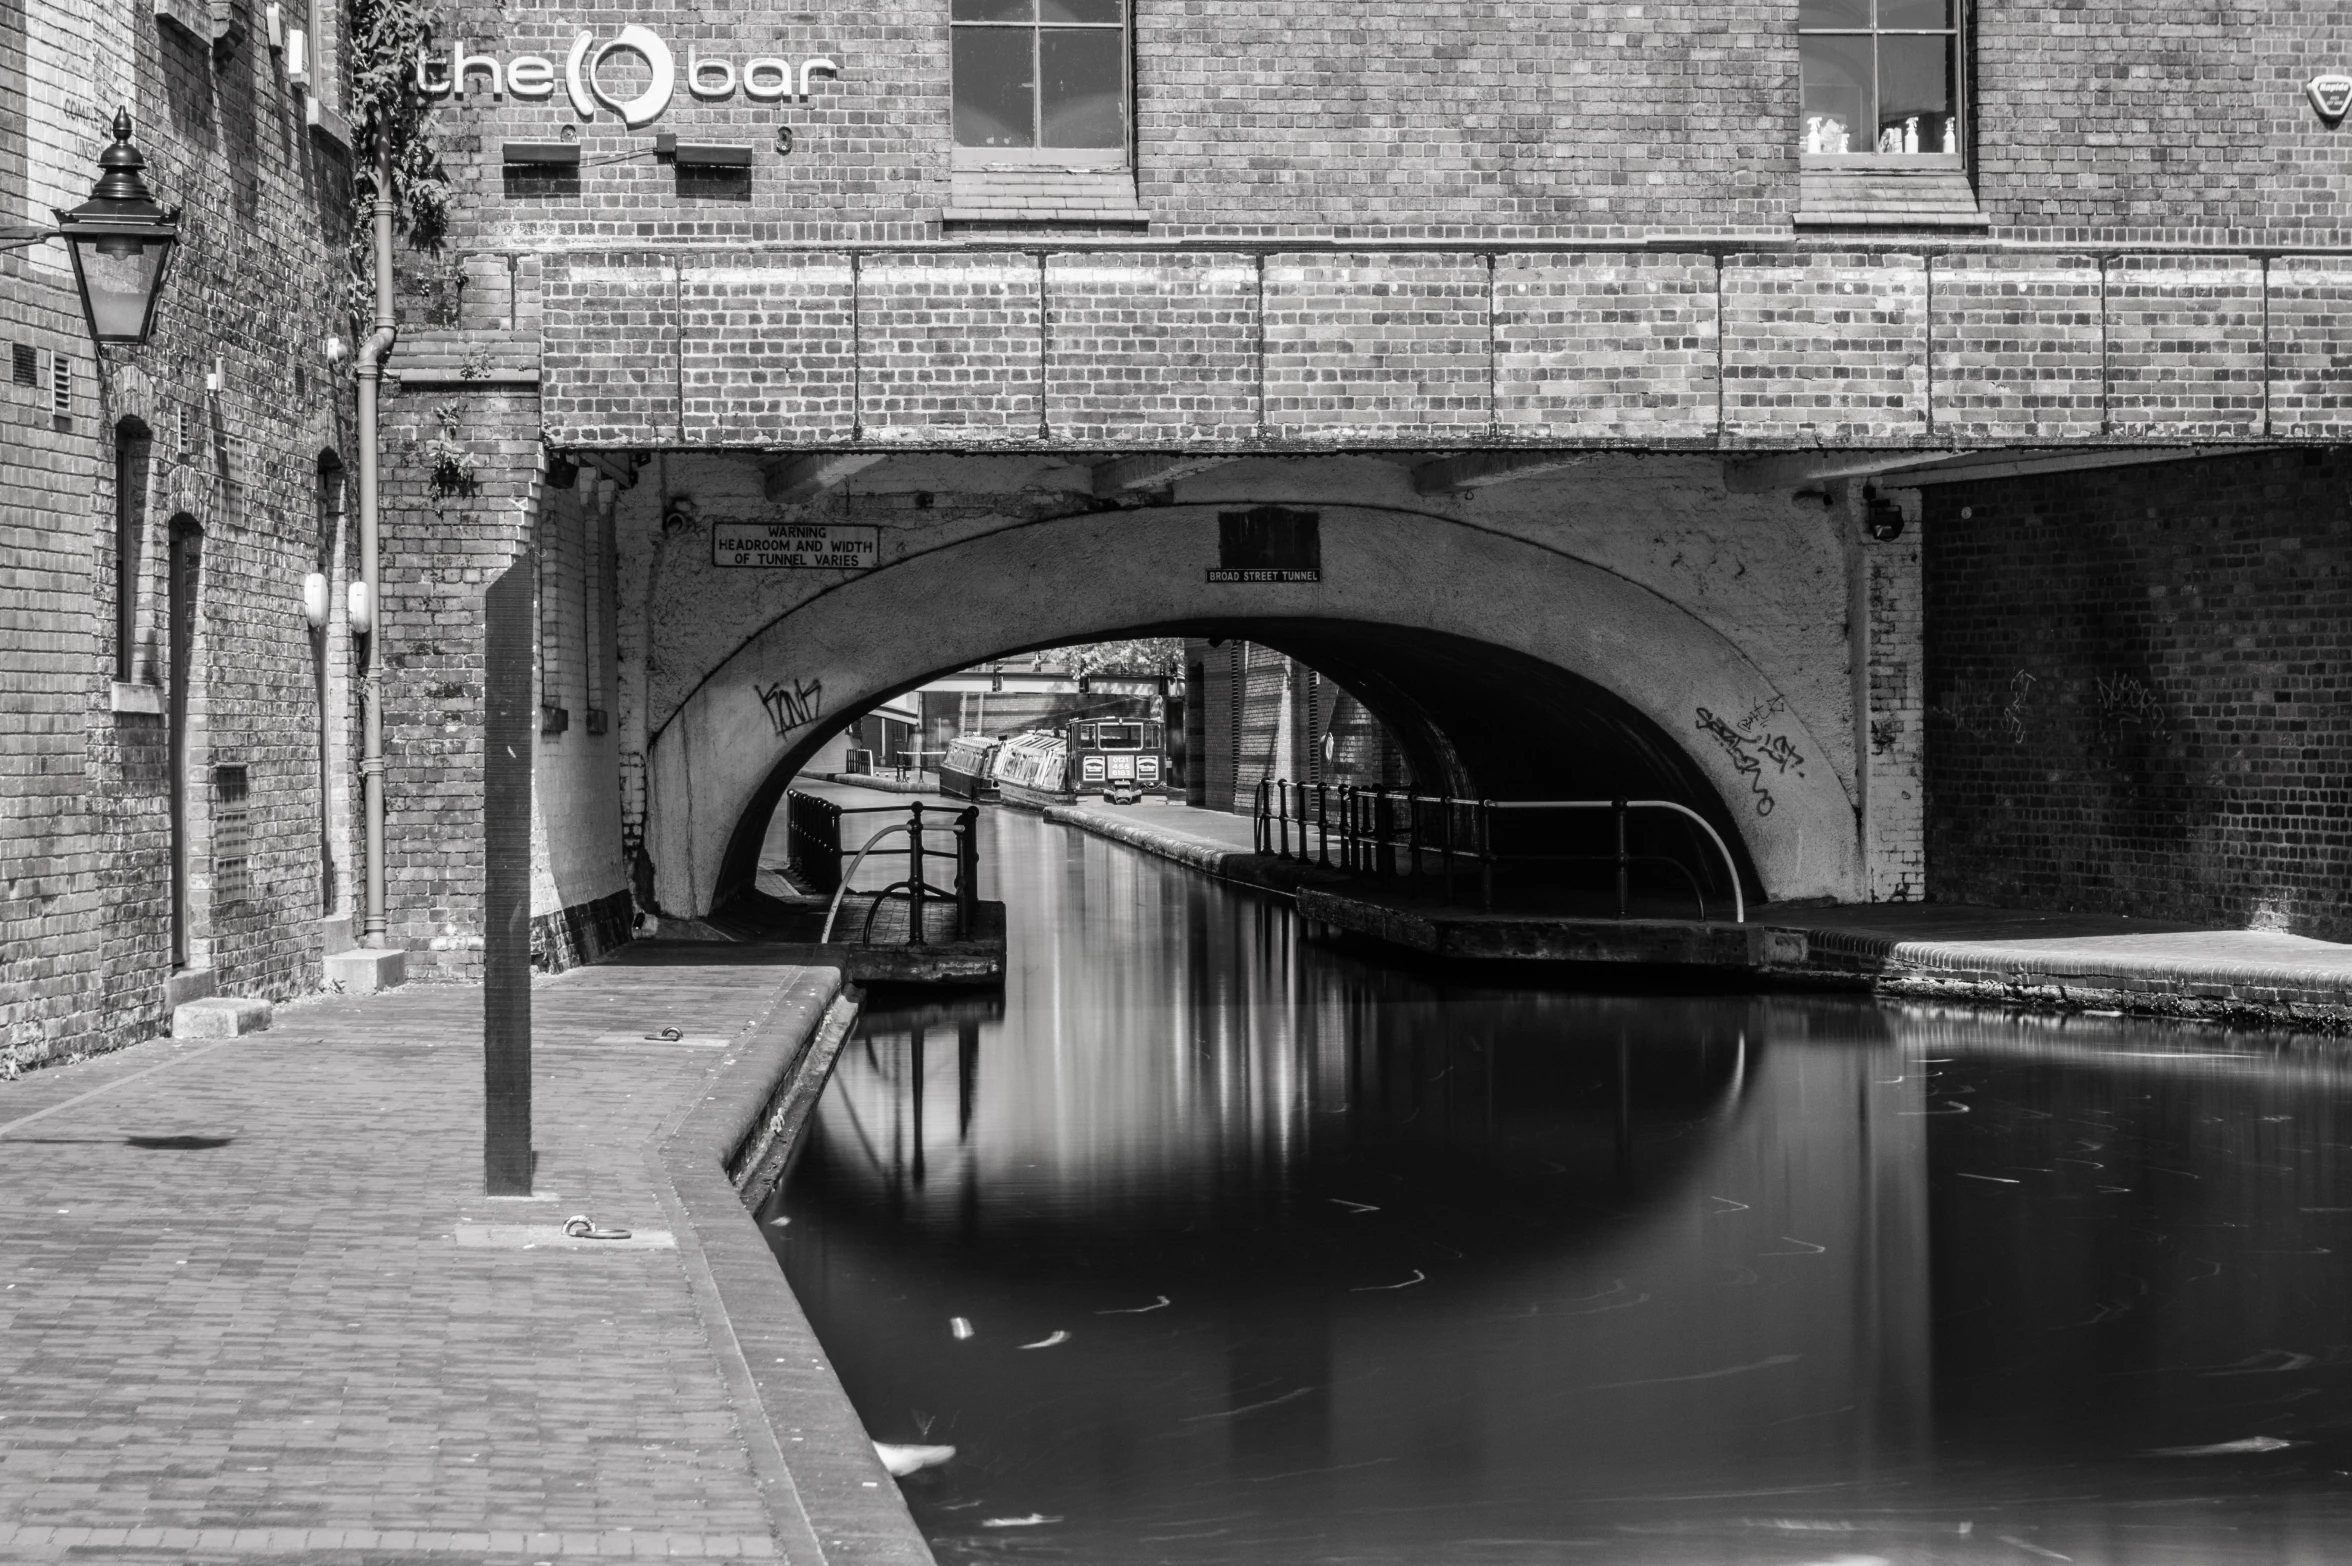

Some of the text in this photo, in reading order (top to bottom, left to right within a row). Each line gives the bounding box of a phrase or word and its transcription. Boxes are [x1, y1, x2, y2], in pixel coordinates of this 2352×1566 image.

[416, 41, 554, 96] the
[687, 44, 837, 97] bar
[768, 526, 827, 539] WARNING
[719, 539, 873, 553] HEADROOM AND WIDTH
[735, 553, 859, 567] OF TUNNEL VARIES
[1209, 571, 1318, 581] BROAD STREET TUNNEL
